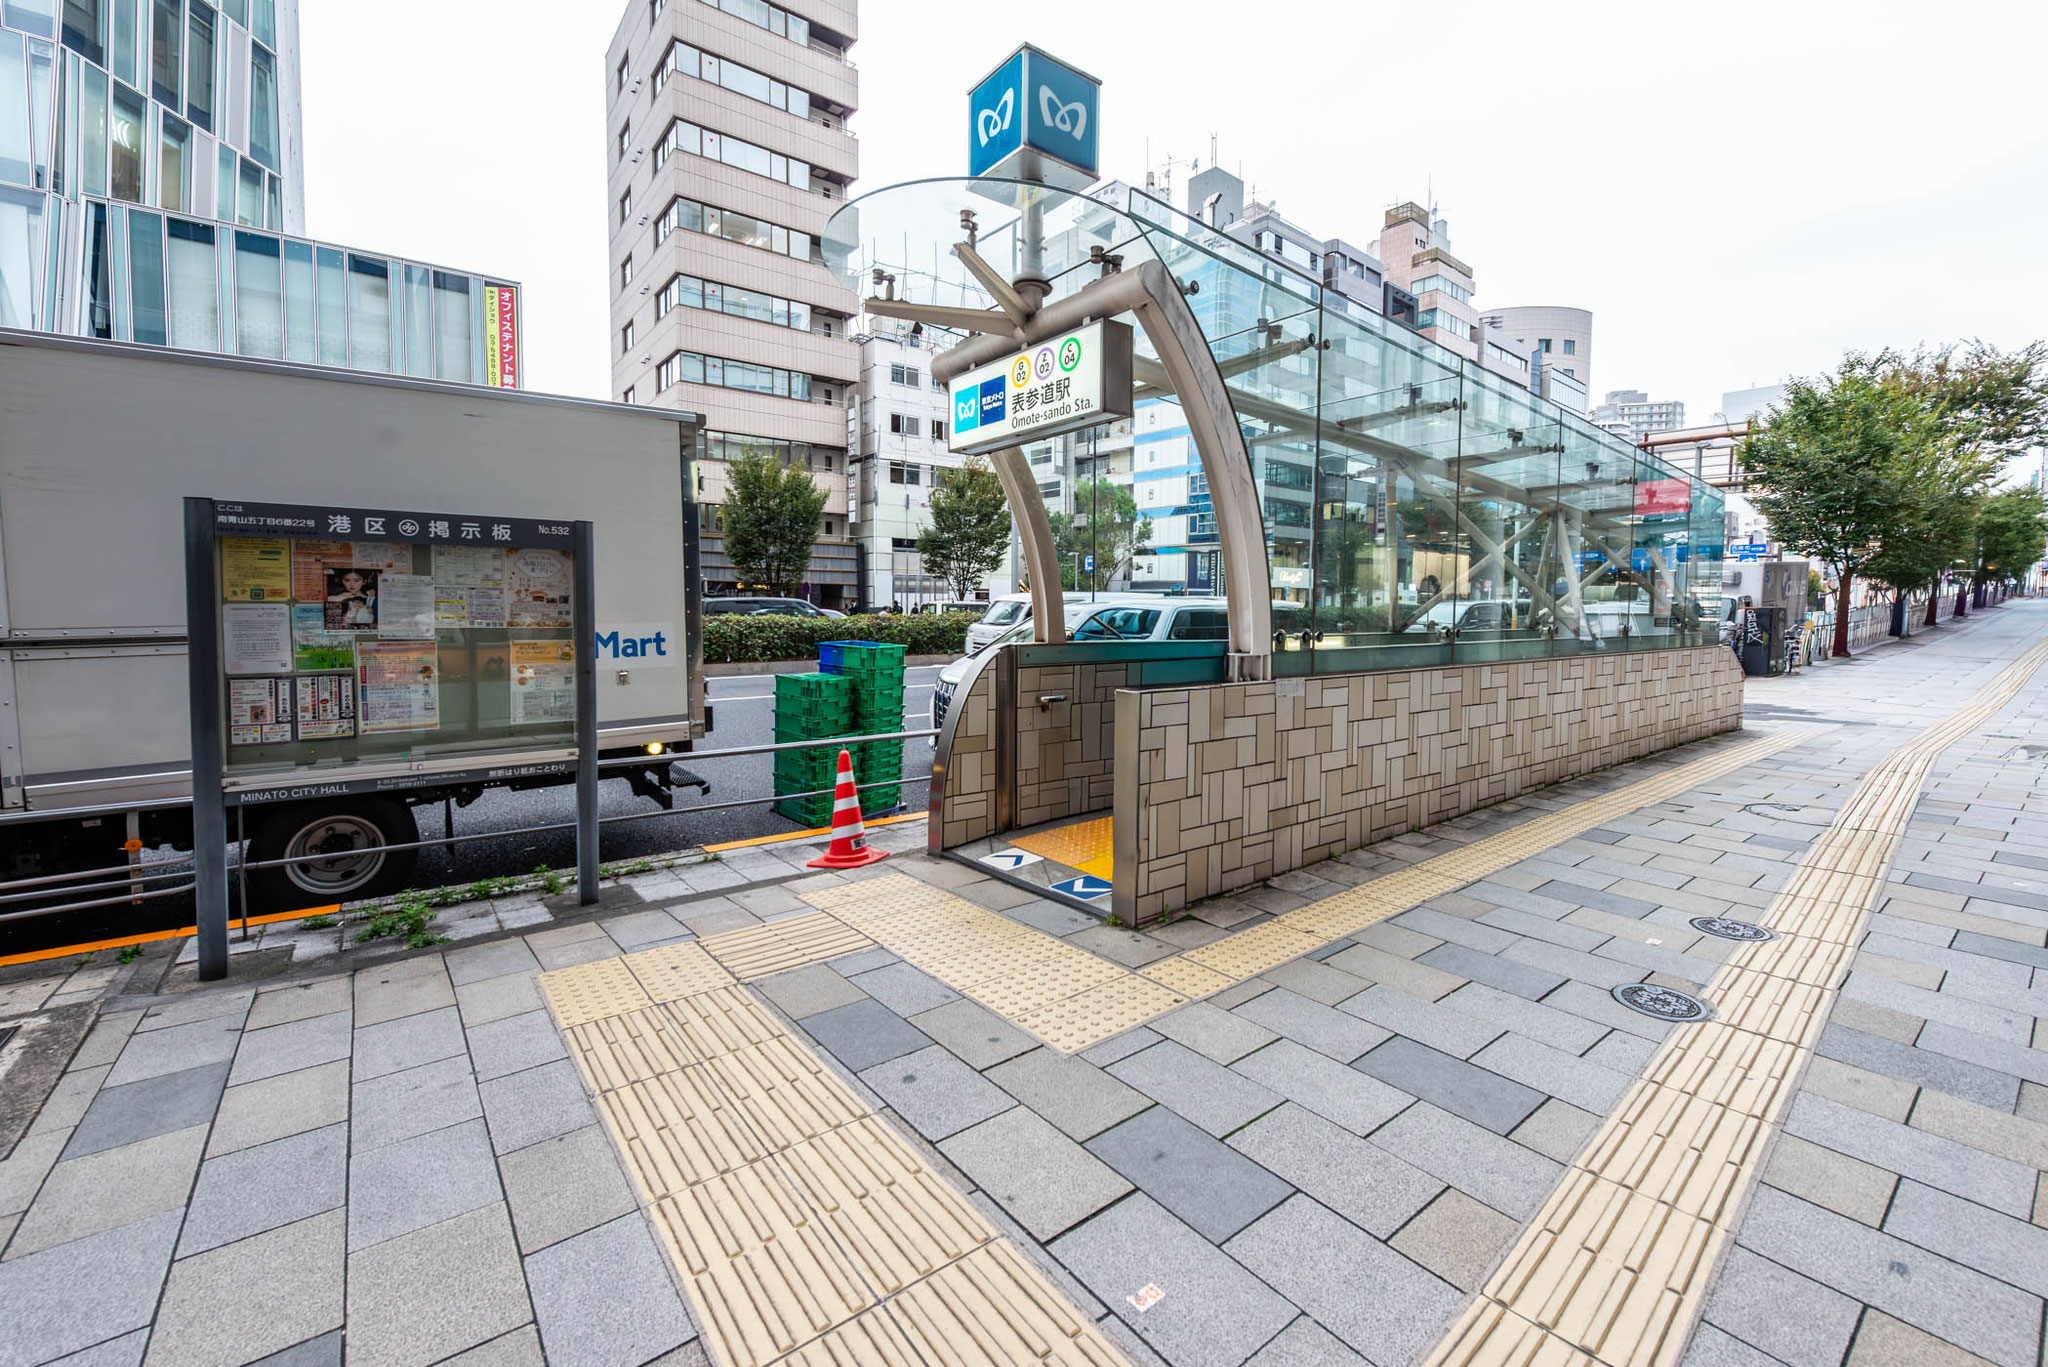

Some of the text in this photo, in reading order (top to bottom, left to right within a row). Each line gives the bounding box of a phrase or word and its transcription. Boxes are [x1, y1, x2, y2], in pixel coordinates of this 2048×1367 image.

[500, 291, 515, 390] オフィステナント募
[1067, 343, 1073, 352] C
[1042, 352, 1047, 362] Z
[1064, 353, 1075, 365] 04
[1018, 361, 1024, 371] G
[1039, 362, 1050, 374] 02
[1016, 370, 1026, 382] 02
[1011, 376, 1071, 415] 表参道駅
[1011, 397, 1094, 429] Omote-sando Sta.
[216, 504, 243, 512] ここは
[216, 515, 316, 528] 南青山五丁目6番22号
[538, 524, 570, 536] No.532
[488, 763, 566, 778] 無断はり紙おことわり
[240, 783, 349, 803] MINATO CITY HALL
